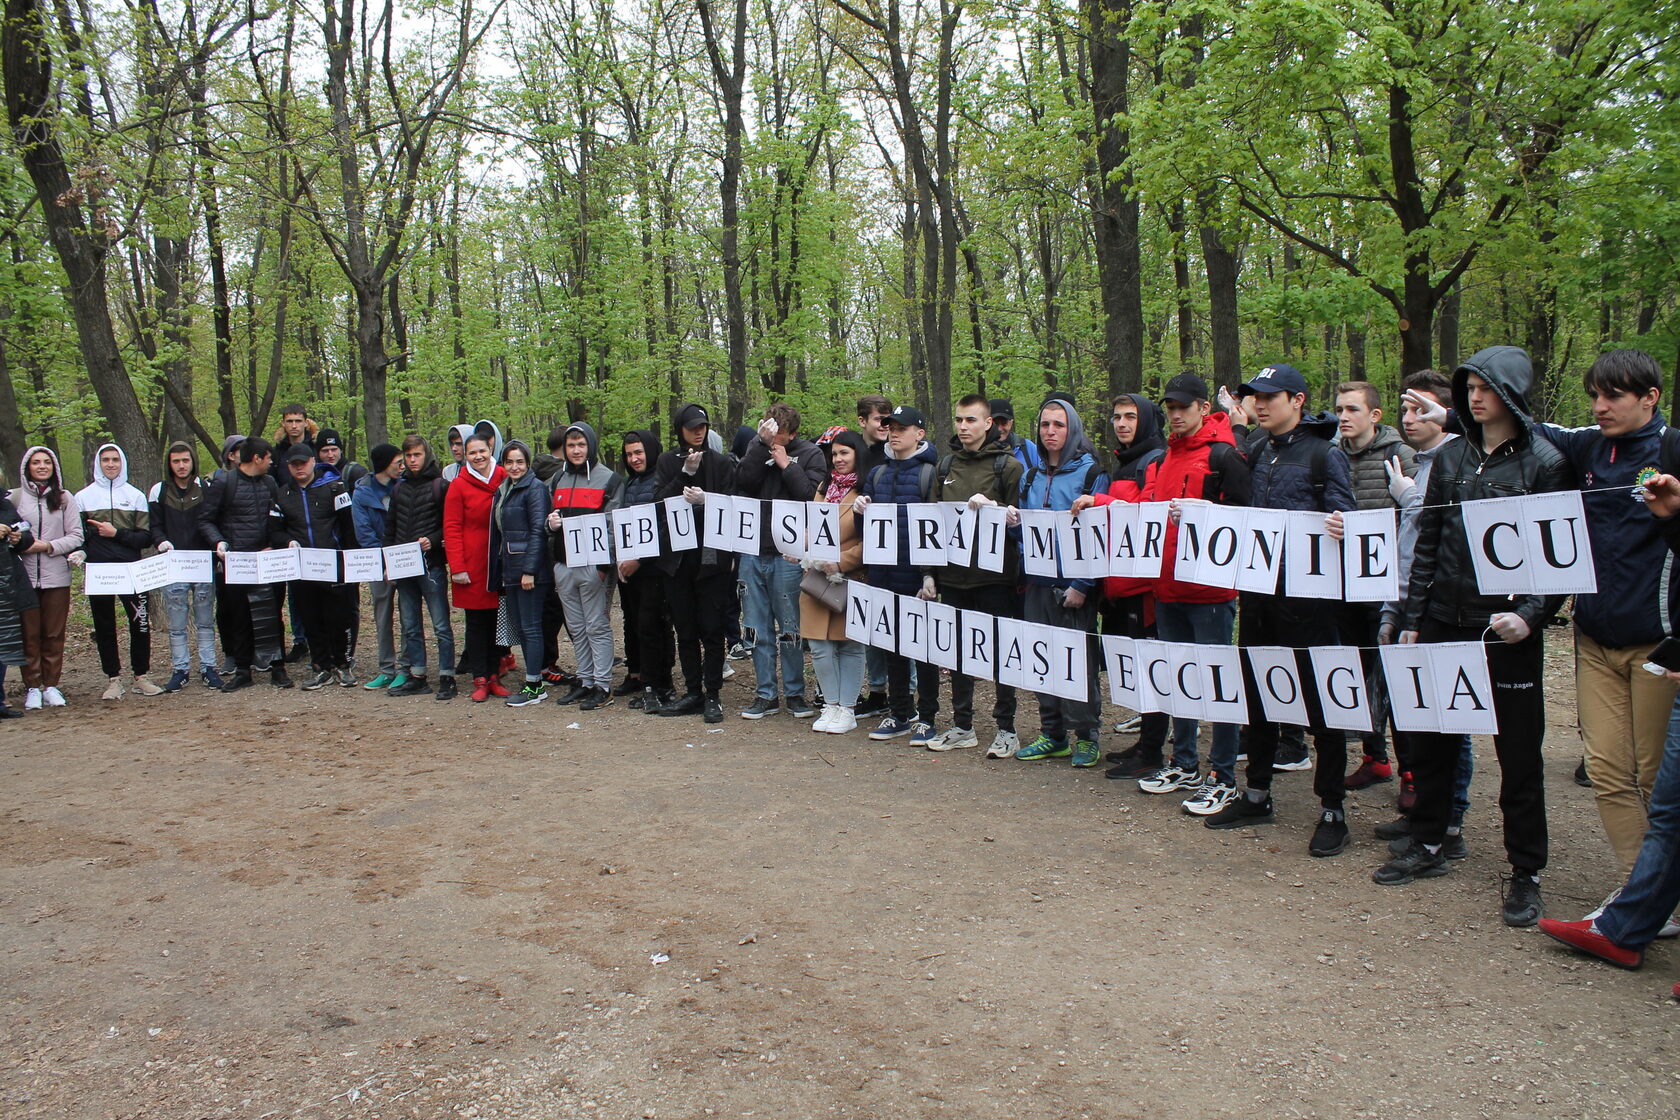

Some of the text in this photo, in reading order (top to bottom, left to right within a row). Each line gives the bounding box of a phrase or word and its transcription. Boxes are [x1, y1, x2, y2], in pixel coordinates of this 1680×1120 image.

[569, 508, 754, 554] TREBUIE
[782, 508, 836, 547] SĂ
[1482, 517, 1579, 571] CU
[851, 595, 1022, 671] NATURA
[1033, 640, 1076, 685] ȘI
